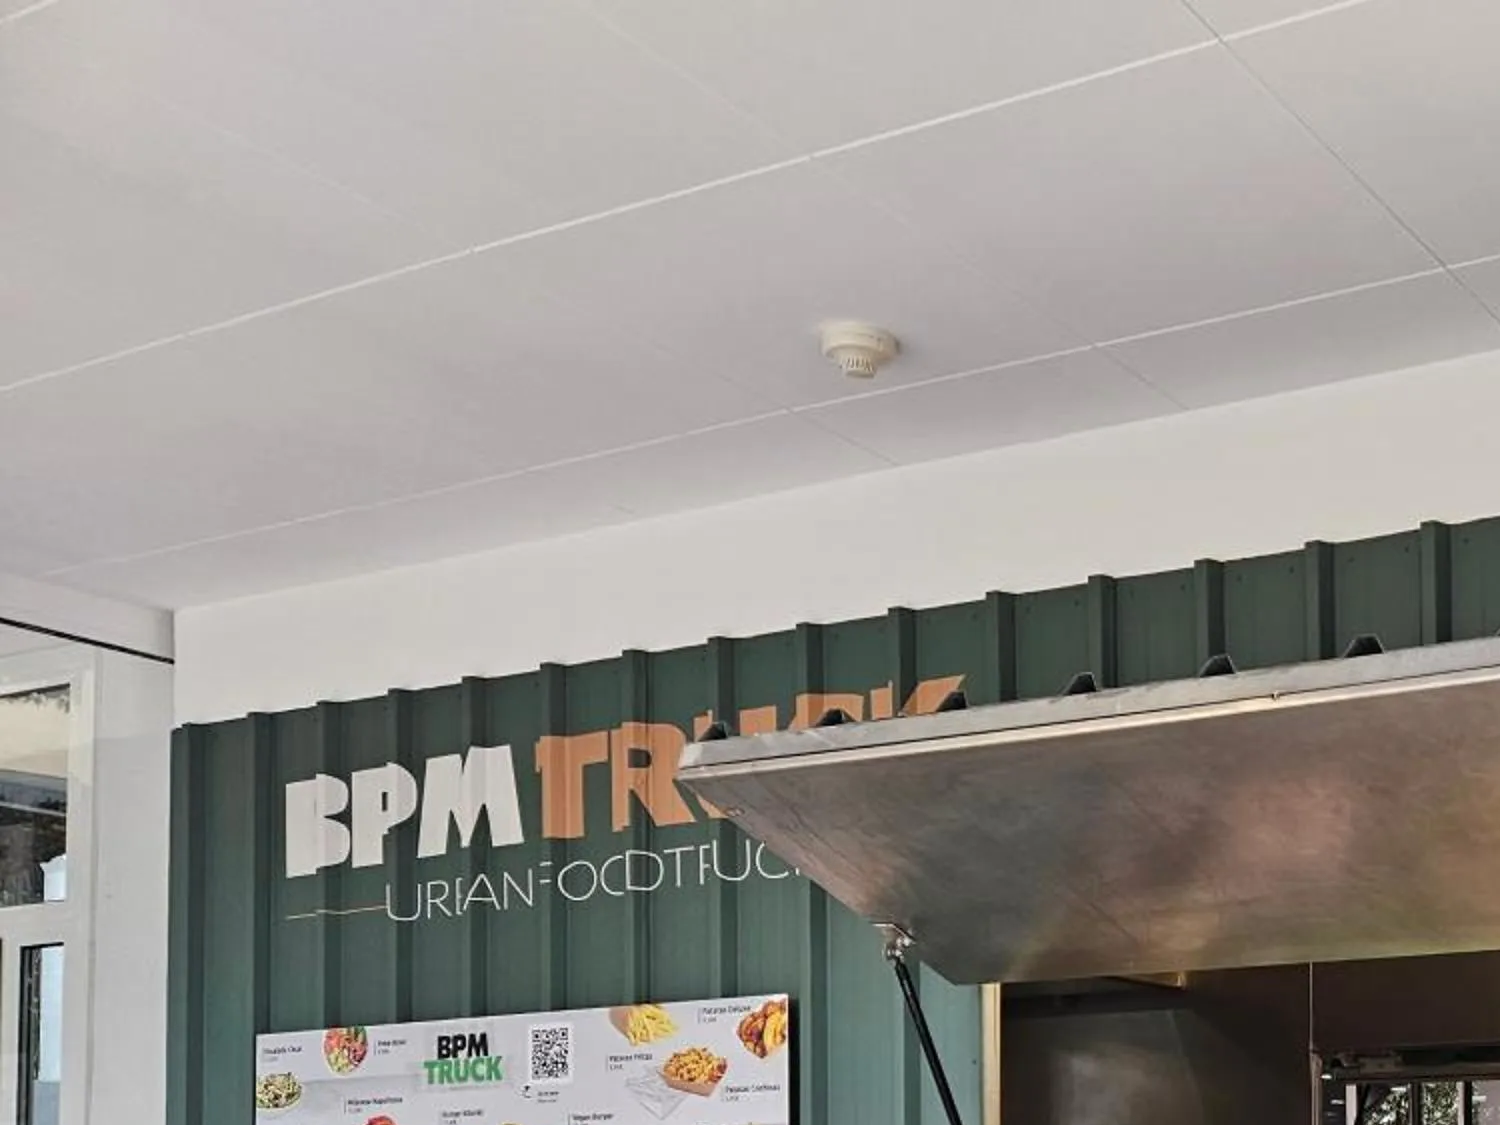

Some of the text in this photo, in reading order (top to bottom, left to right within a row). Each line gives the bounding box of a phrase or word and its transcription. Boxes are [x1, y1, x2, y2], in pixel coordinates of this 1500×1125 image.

[285, 744, 525, 879] BPM
[539, 838, 801, 902] OODTUC
[437, 1032, 489, 1059] BPM
[424, 1056, 503, 1084] TRUCK
